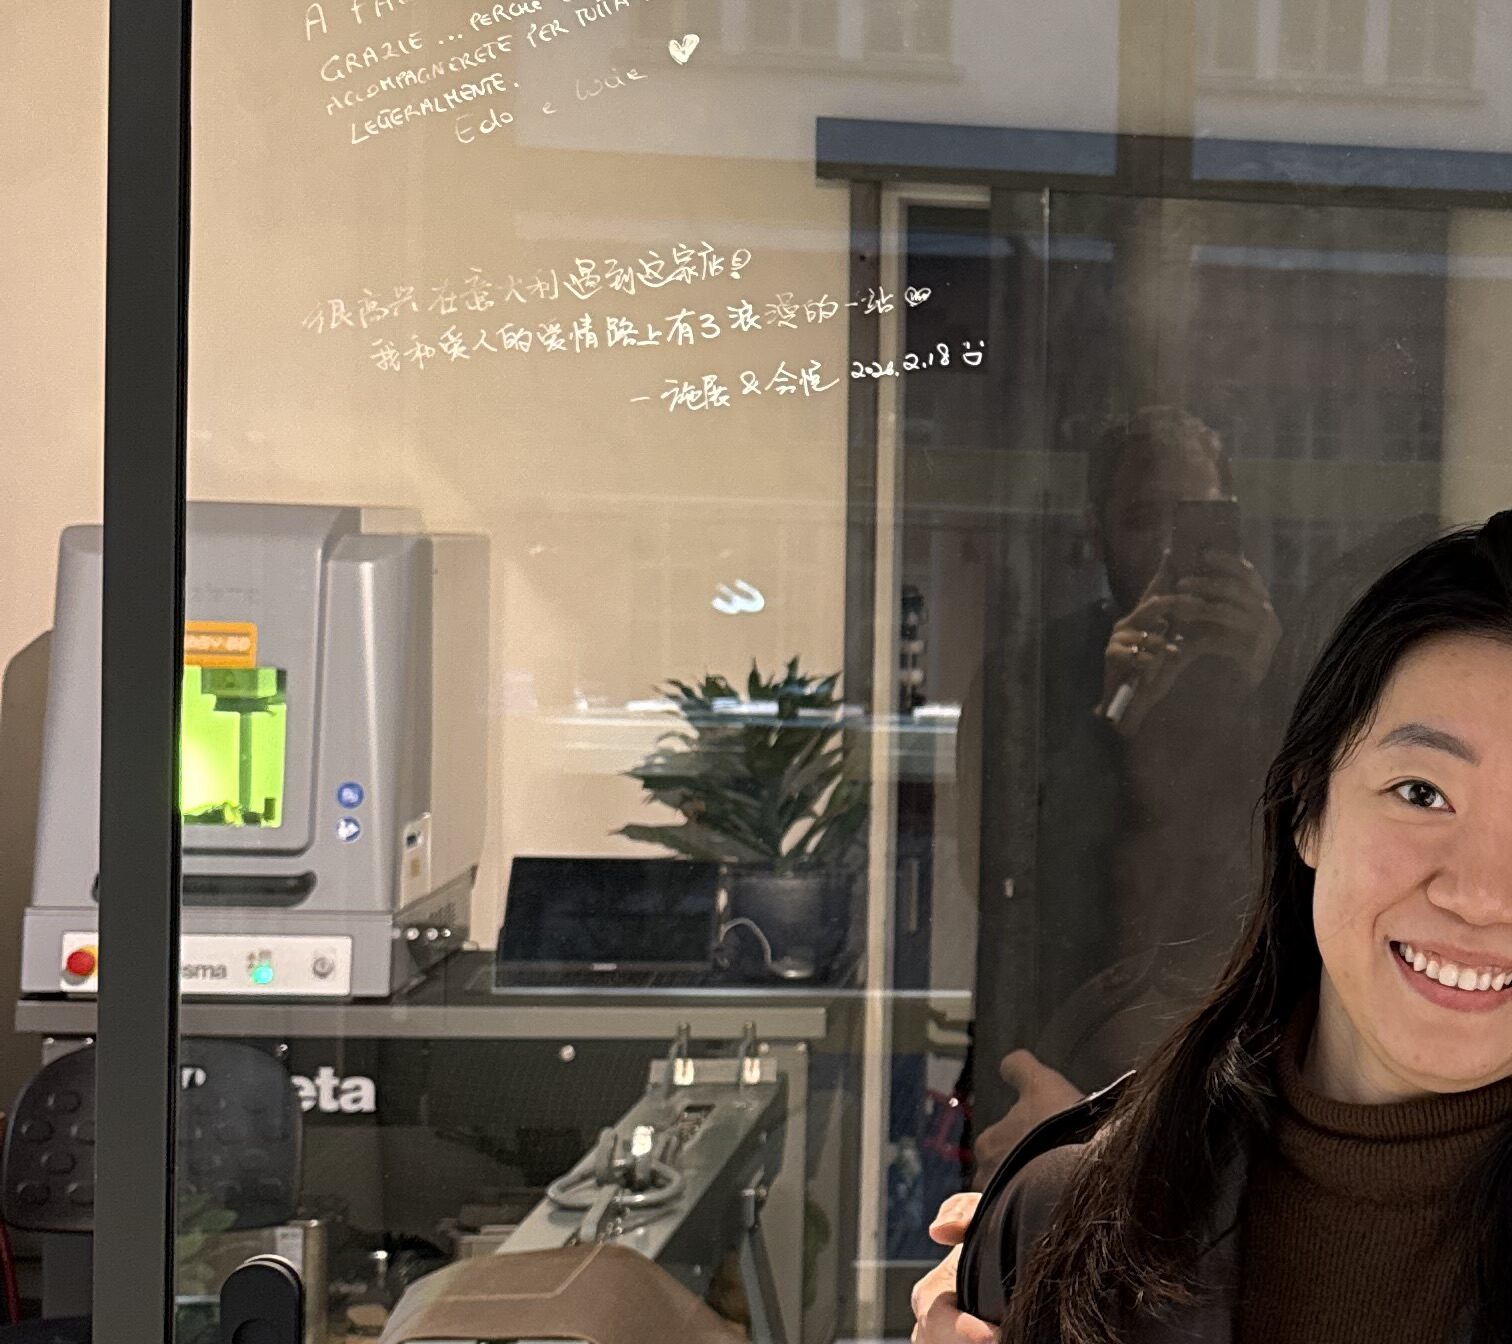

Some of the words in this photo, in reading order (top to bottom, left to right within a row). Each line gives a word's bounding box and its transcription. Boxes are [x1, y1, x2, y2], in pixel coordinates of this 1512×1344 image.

[304, 1, 328, 40] A
[527, 18, 570, 48] PER
[320, 32, 424, 82] GRAZIE
